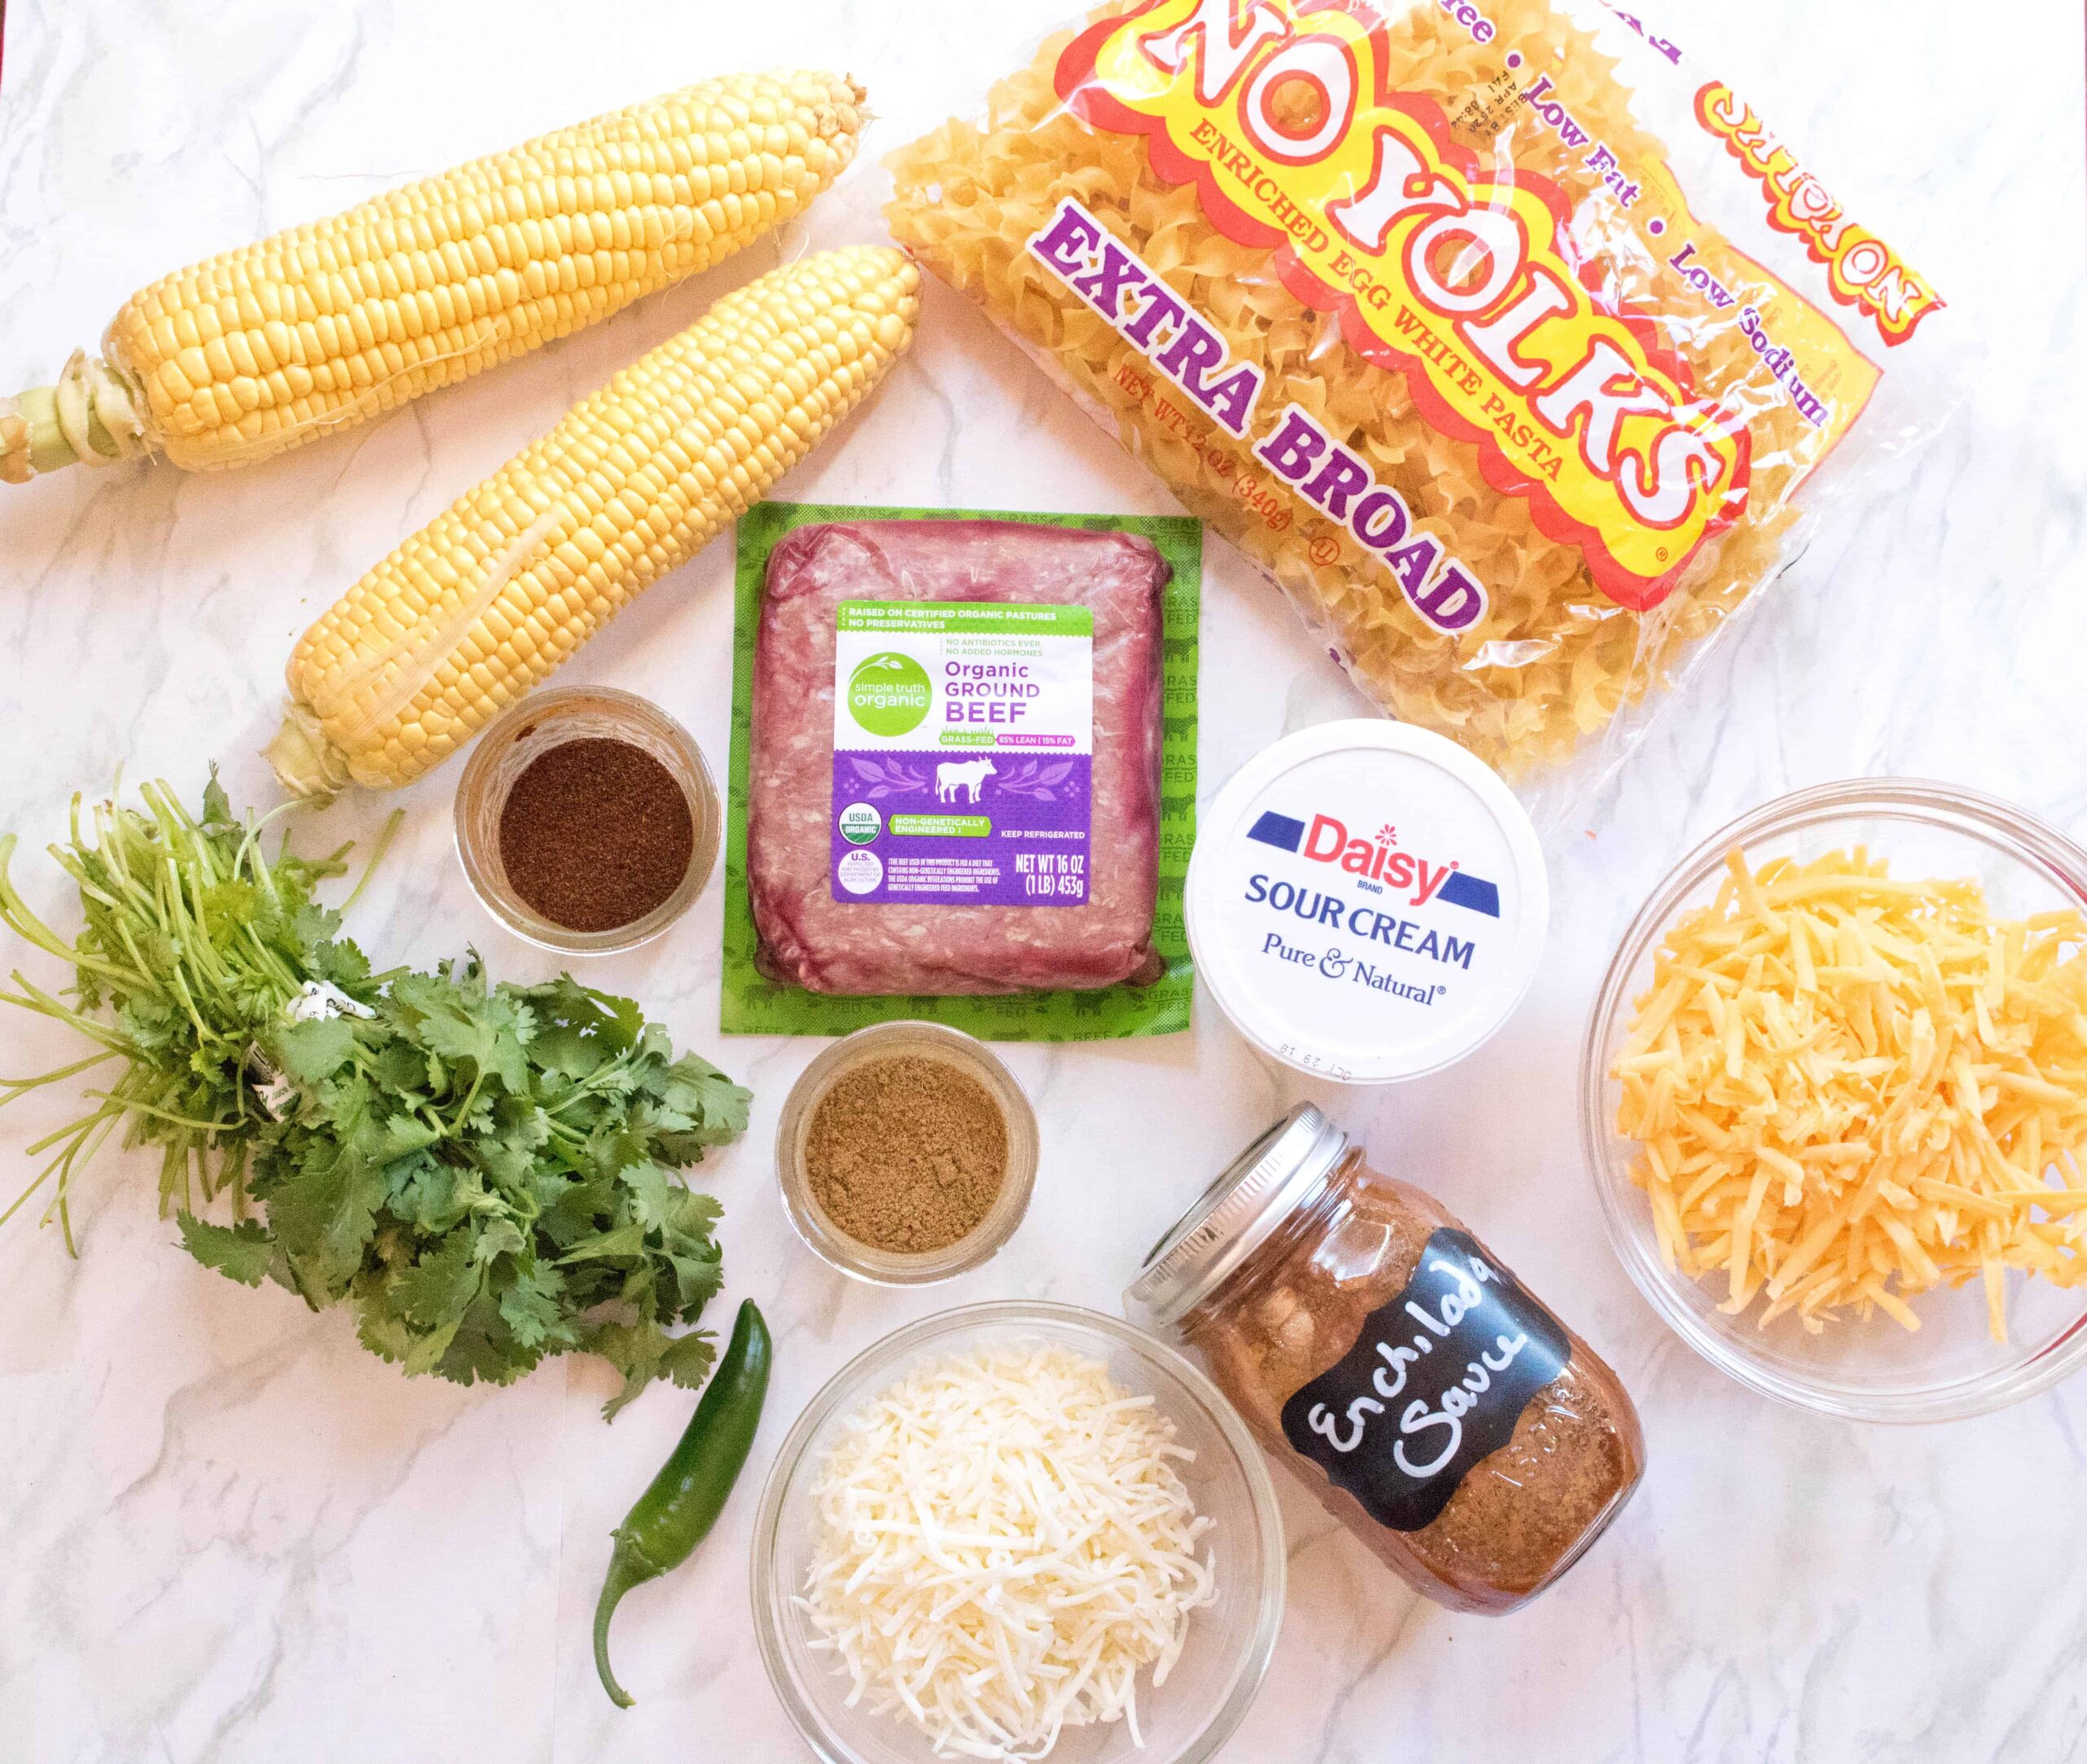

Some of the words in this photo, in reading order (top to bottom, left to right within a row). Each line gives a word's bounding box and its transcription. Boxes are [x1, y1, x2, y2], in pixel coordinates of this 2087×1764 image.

[1494, 82, 1517, 105] APR
[1525, 77, 1588, 147] Low
[1586, 145, 1639, 207] Fat
[1139, 0, 1359, 165] NO
[1324, 122, 1727, 531] YOLKS
[1189, 117, 1329, 253] ENRICHED
[1328, 250, 1392, 311] EGG
[1394, 304, 1484, 396] WHITE
[1480, 392, 1564, 482] PASTA
[1670, 244, 1735, 307] Low
[1739, 308, 1829, 427] Sodium
[1031, 202, 1263, 435] EXTRA
[1259, 410, 1483, 631] BROAD
[1113, 364, 1154, 406] NET
[1154, 398, 1185, 432] WT
[1232, 473, 1293, 532] (340g)
[849, 608, 885, 617] RAISED
[887, 609, 902, 617] ON
[905, 610, 955, 618] CERTIFIED
[958, 610, 1004, 619] ORGANIC
[1006, 611, 1057, 620] PASTURES
[849, 619, 864, 627] NO
[867, 620, 946, 628] PRESERVATIVES
[1018, 640, 1043, 648] EVER,
[994, 649, 1044, 657] HORMONES
[945, 661, 1029, 680] Organic
[855, 681, 893, 693] simple
[896, 682, 925, 693] truth
[945, 681, 1040, 697] GROUND
[854, 693, 925, 709] organic
[946, 701, 1027, 723] BEEF
[942, 735, 994, 743] GRASS-FED
[1016, 736, 1036, 744] LEAN
[849, 812, 873, 822] USDA
[895, 817, 985, 827] NON-GENETICALLY
[845, 825, 876, 834] ORGANIC
[895, 825, 955, 834] ENGINEERED
[1024, 831, 1085, 839] REFRIGERATED
[851, 853, 870, 861] U.S.
[1016, 854, 1035, 873] NET
[1037, 854, 1054, 873] WT
[1057, 854, 1068, 874] 16
[1070, 855, 1084, 874] OZ
[1303, 813, 1450, 907] Daisy
[1026, 874, 1035, 896] (1
[1038, 874, 1056, 896] LB)
[1058, 875, 1083, 897] 453g
[1357, 880, 1383, 895] BRAND
[1244, 874, 1345, 928] SOUR
[1348, 908, 1476, 971] CREAM
[1262, 933, 1316, 968] Pure
[1318, 948, 1354, 978] &
[1308, 1255, 1503, 1453] Enchilada
[1395, 1334, 1529, 1478] Sauce
